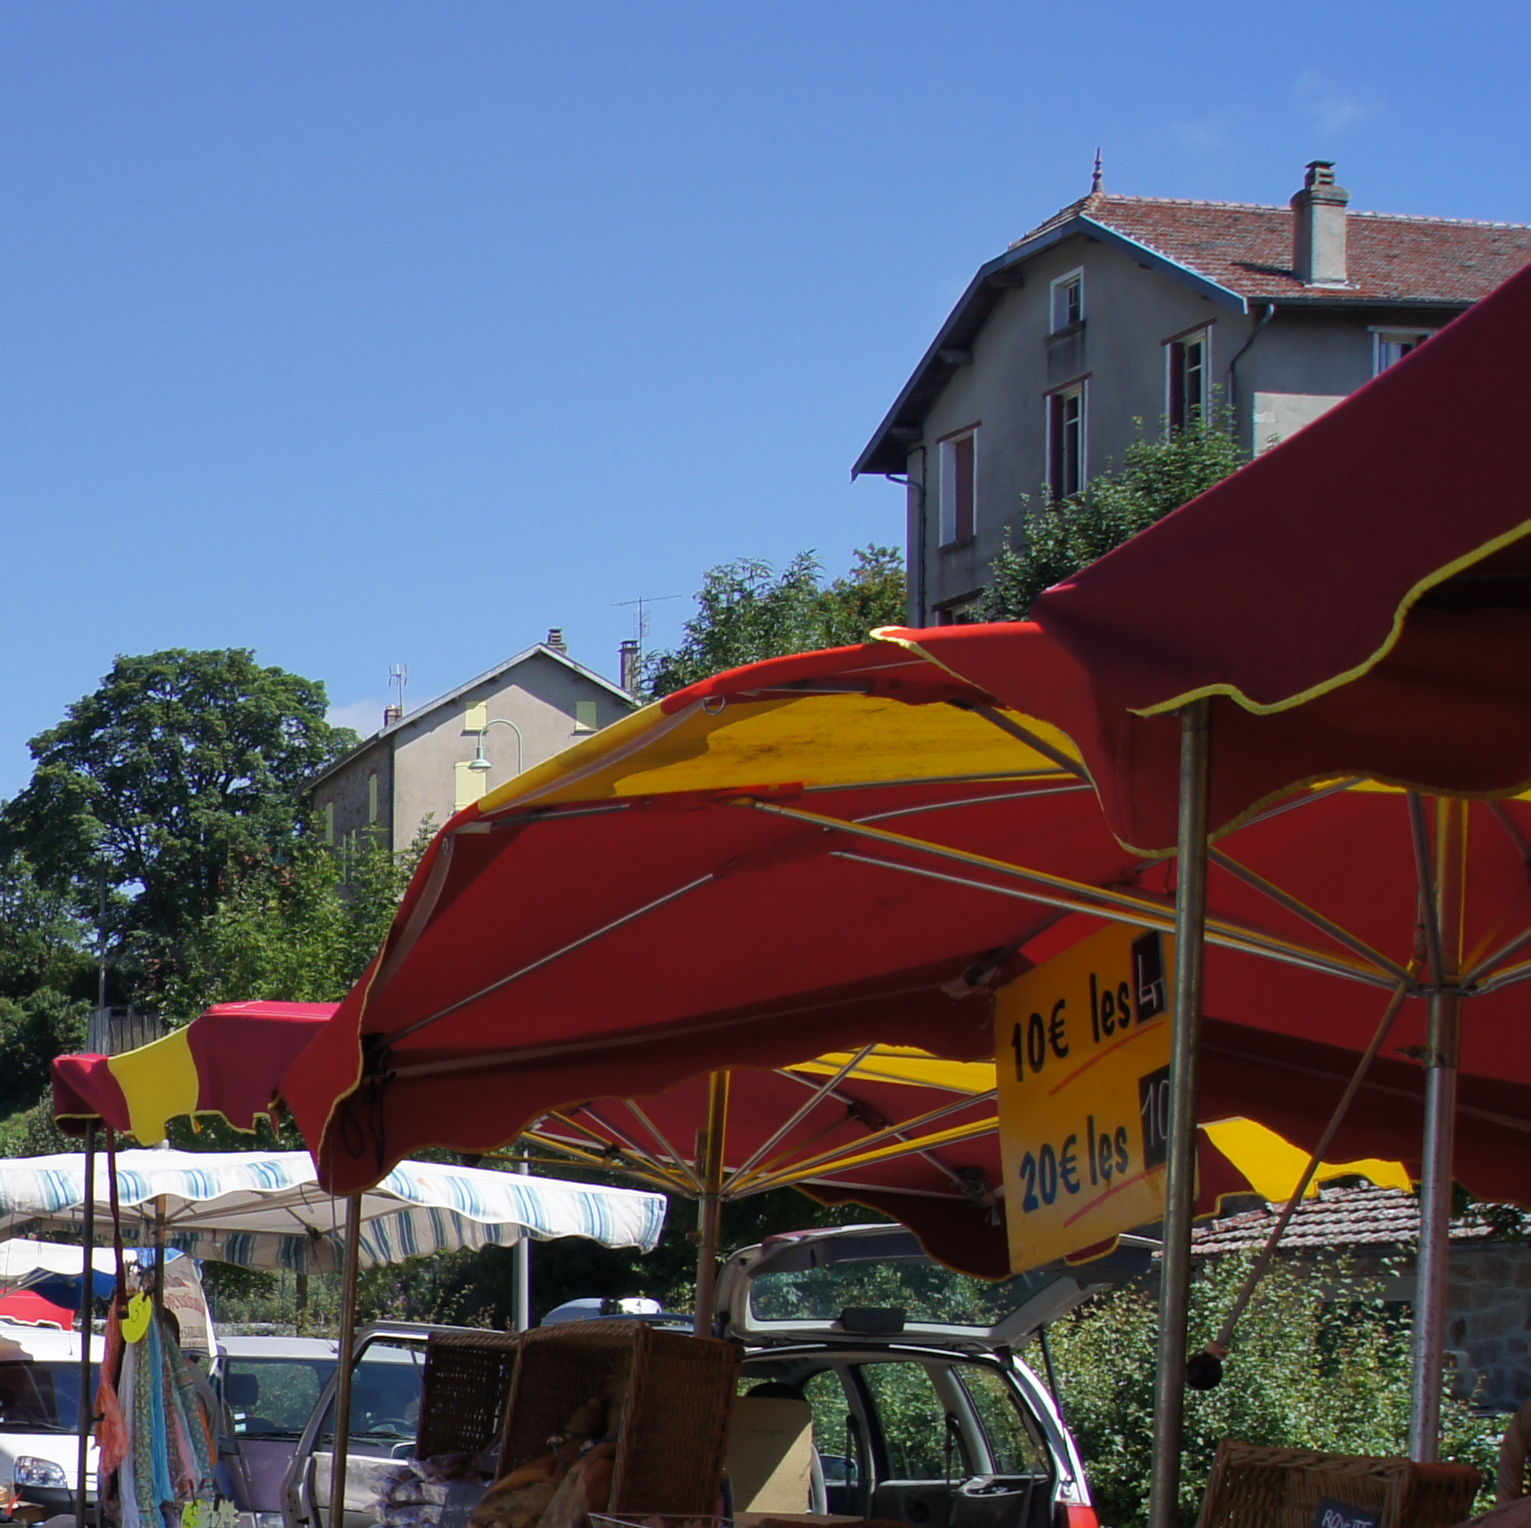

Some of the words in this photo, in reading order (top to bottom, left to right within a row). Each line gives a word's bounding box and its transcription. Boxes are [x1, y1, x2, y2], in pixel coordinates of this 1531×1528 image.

[1012, 997, 1069, 1083] 10€
[1090, 973, 1130, 1043] les
[1020, 1135, 1082, 1214] 20€
[1087, 1115, 1129, 1185] les
